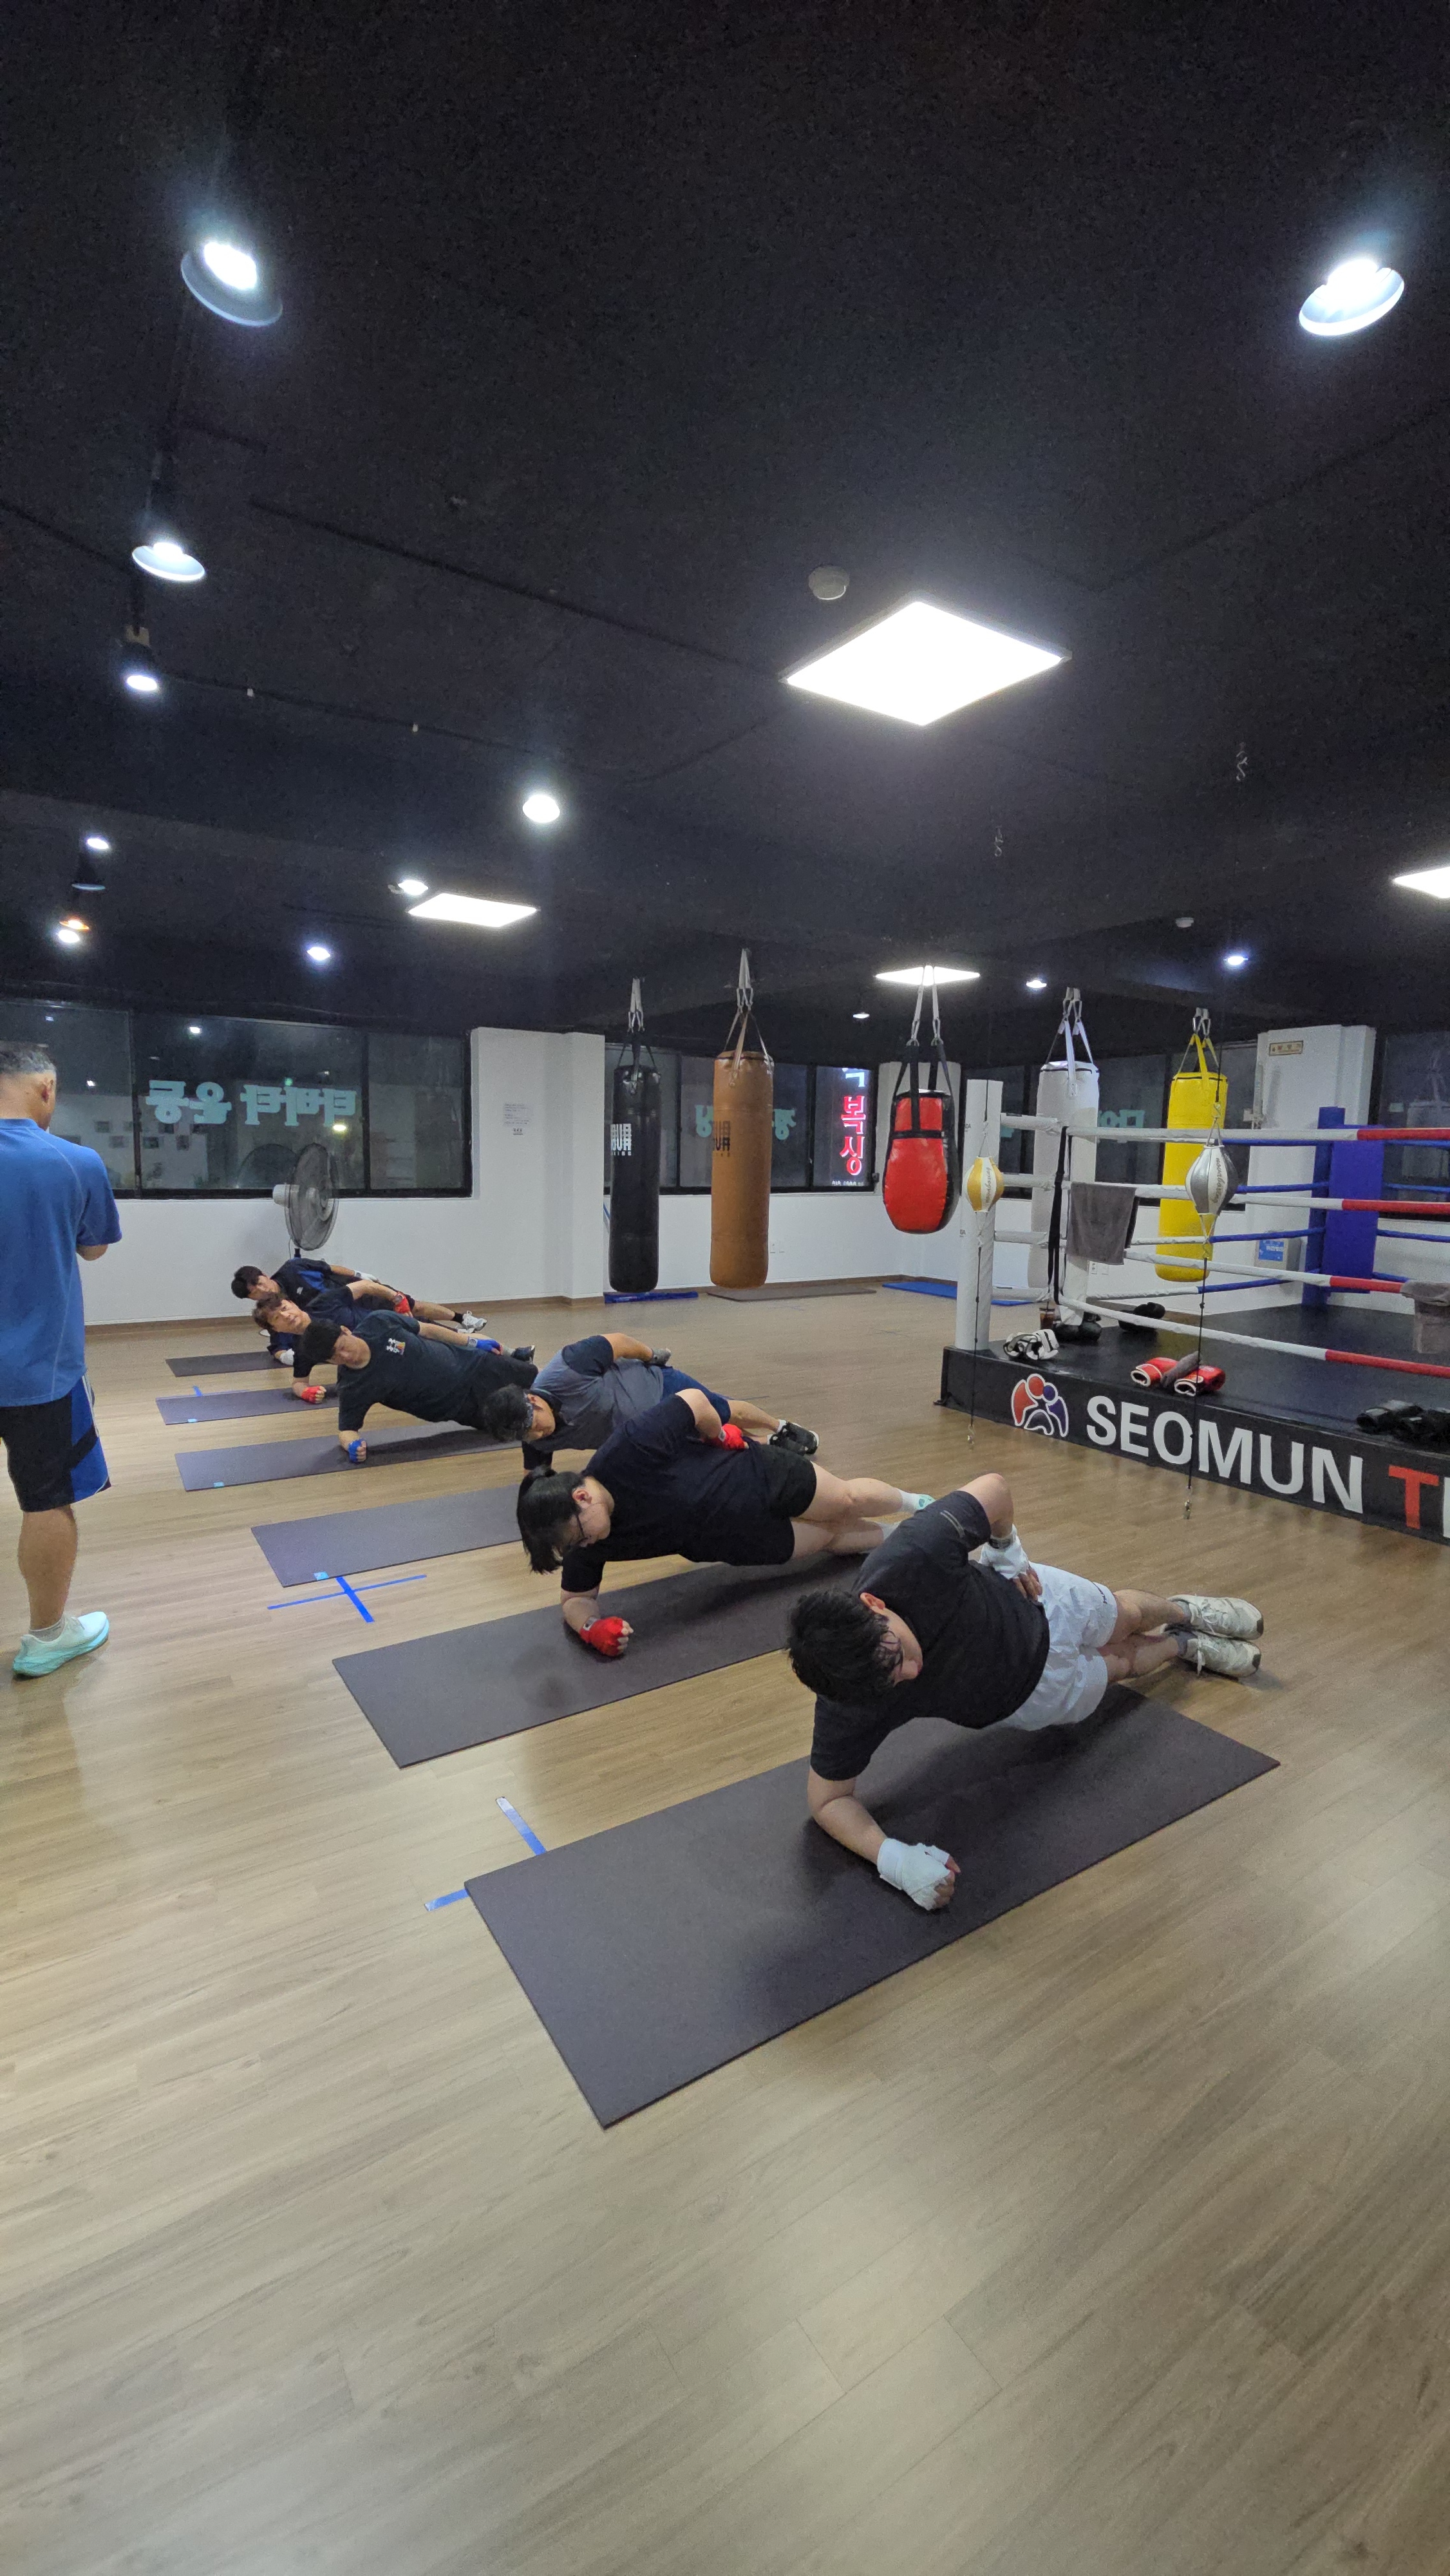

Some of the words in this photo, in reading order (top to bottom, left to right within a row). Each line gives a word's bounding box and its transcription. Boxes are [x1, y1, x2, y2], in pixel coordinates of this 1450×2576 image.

[840, 1095, 867, 1176] 복싱
[1086, 1395, 1363, 1513] SEOMUN
[1389, 1465, 1450, 1538] T
